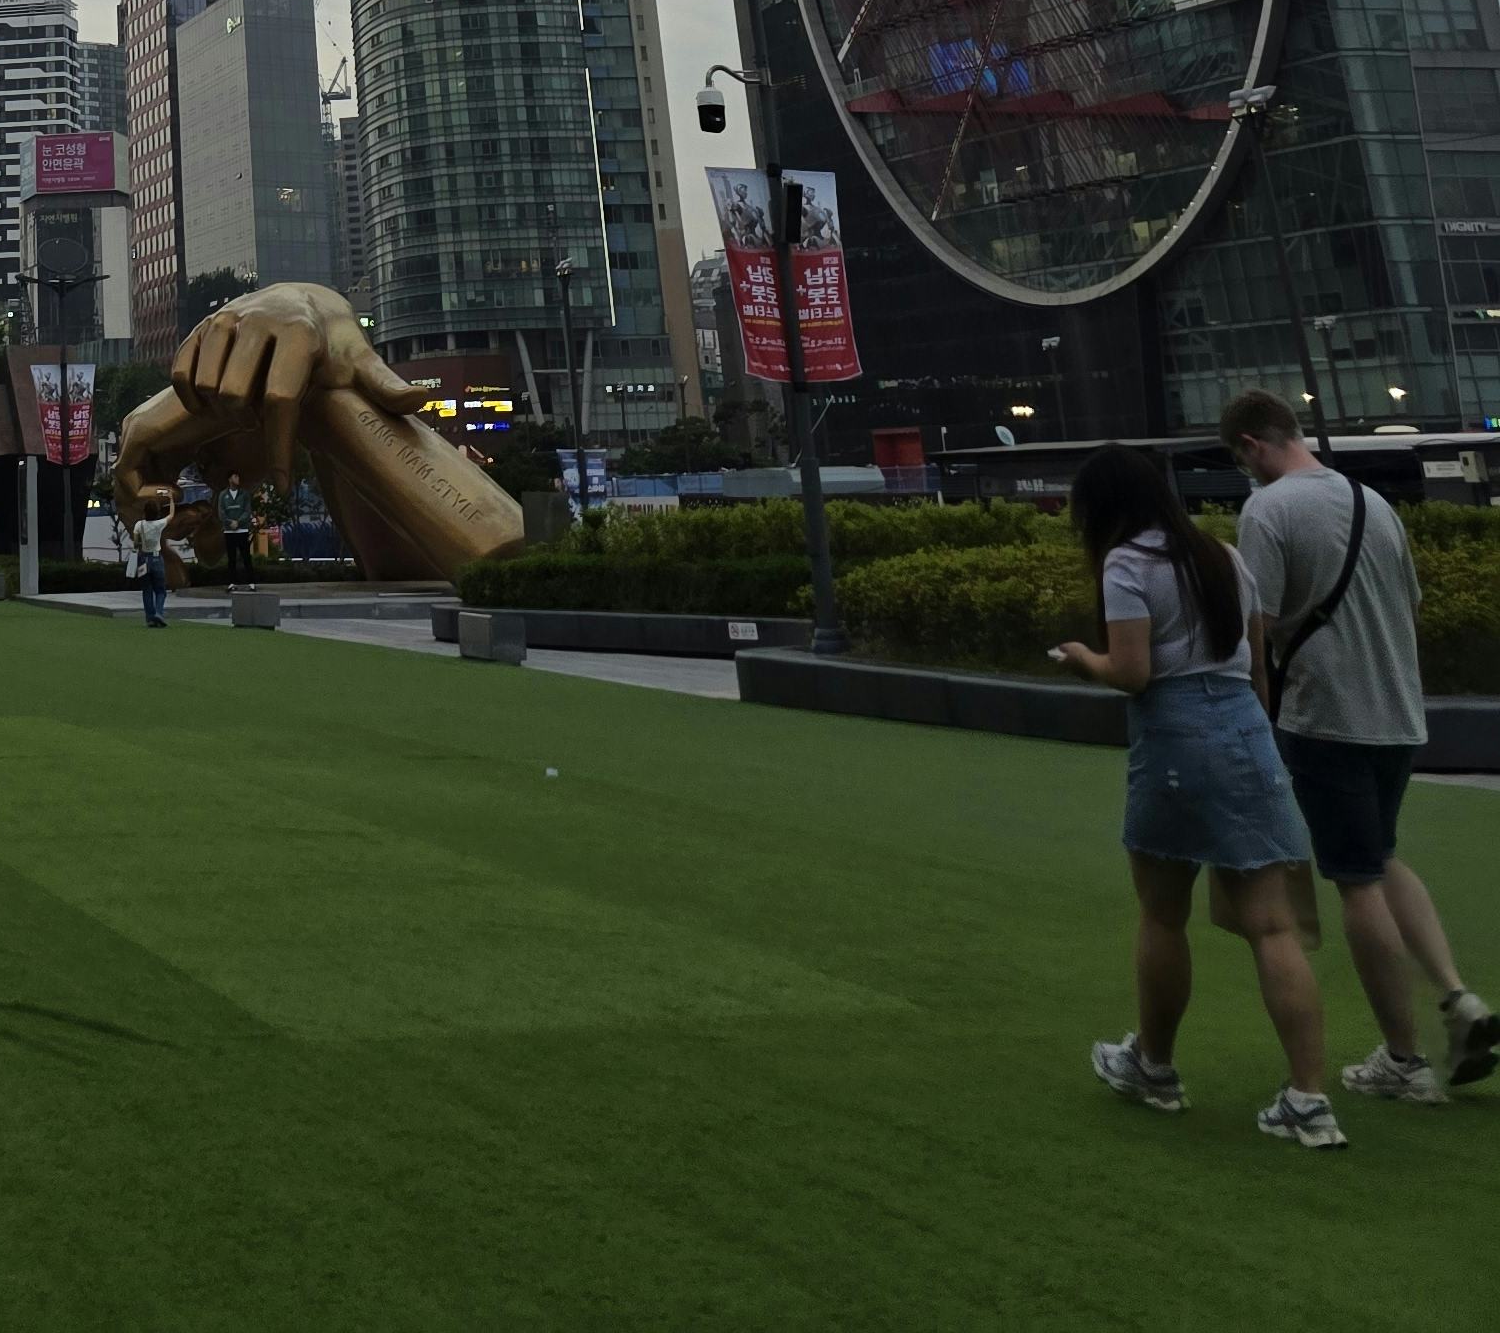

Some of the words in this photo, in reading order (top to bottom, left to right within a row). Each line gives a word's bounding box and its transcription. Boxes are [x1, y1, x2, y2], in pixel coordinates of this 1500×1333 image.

[42, 144, 52, 157] 눈
[55, 142, 86, 156] 코성형
[42, 158, 84, 172] 안면윤곽
[357, 410, 399, 447] GANG
[396, 445, 435, 481] NAM
[431, 478, 485, 522] STYLE
